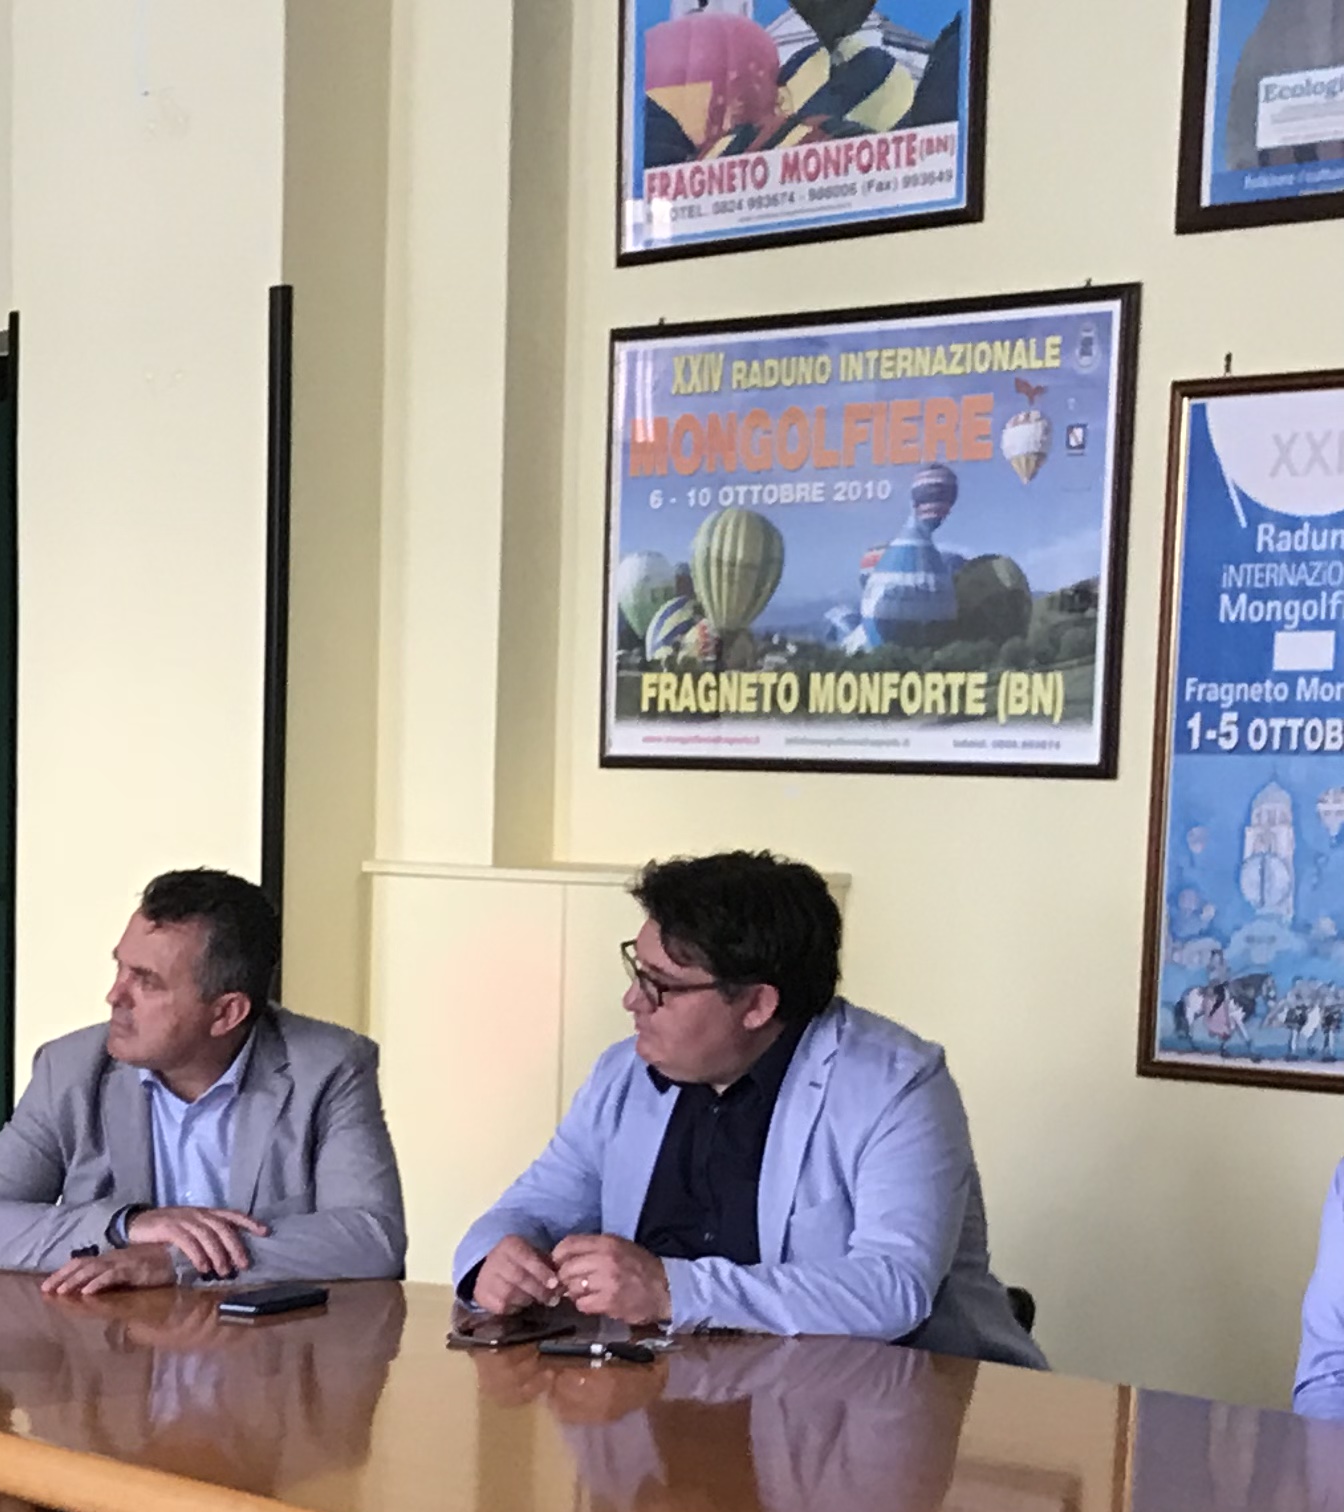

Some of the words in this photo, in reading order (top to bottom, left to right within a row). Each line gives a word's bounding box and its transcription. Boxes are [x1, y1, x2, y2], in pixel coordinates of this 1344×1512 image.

[646, 158, 769, 201] FRAGNETO
[779, 132, 917, 185] MONFORTE
[919, 134, 955, 161] (BN)
[671, 352, 725, 395] XXIV
[732, 355, 831, 390] RADUNO
[840, 336, 1063, 382] INTERNAZIONALE
[629, 393, 994, 477] MONGOLFIERE
[649, 493, 664, 508] 6
[688, 489, 710, 506] 10
[718, 482, 825, 507] OTTOBRE
[833, 478, 892, 502] 2010
[641, 671, 799, 714] FRAGNETO
[809, 671, 988, 715] MONFORTE
[997, 671, 1064, 724] (BN)
[1185, 676, 1289, 708] Fragneto
[1247, 717, 1344, 752] OTTOB
